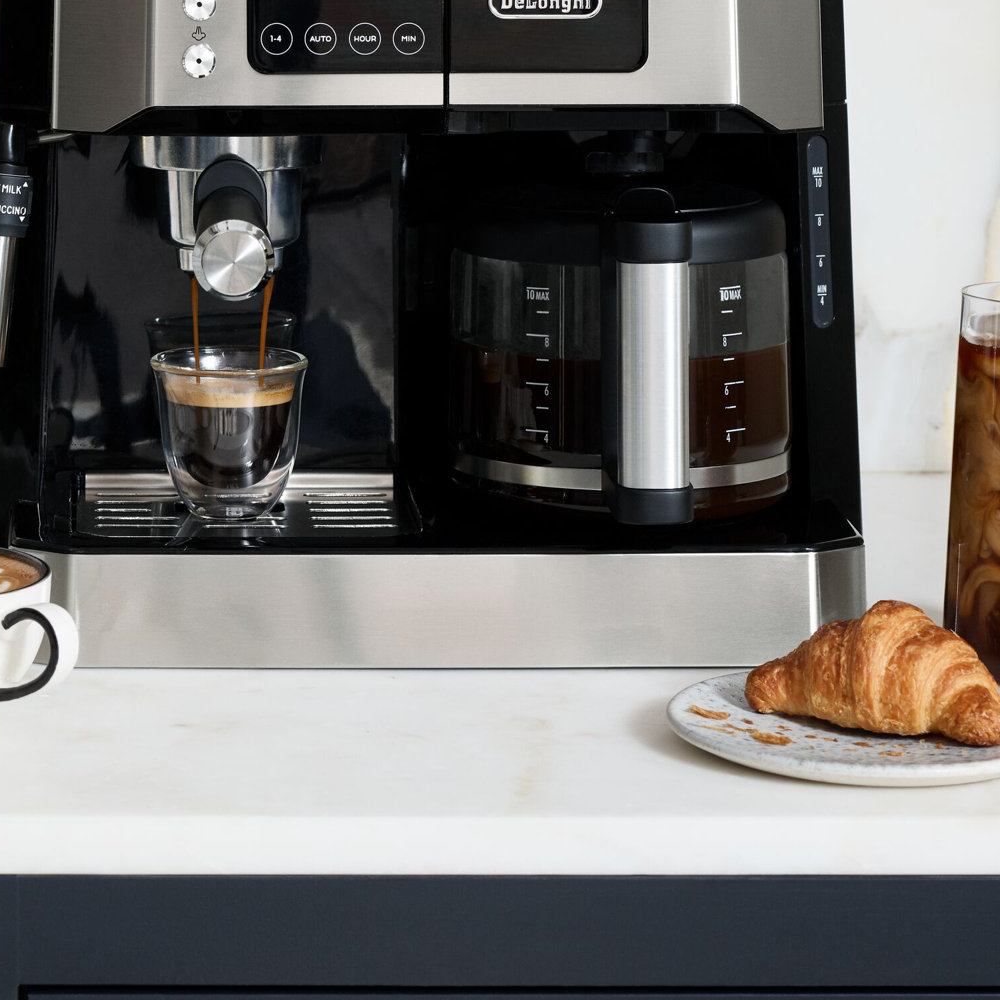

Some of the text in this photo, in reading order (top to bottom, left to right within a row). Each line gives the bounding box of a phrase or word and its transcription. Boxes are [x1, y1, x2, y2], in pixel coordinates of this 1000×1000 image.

[269, 34, 282, 43] 1-4
[309, 34, 332, 43] AUTO
[353, 34, 377, 43] HOUR
[401, 34, 417, 43] MIN
[812, 166, 823, 175] MAX
[815, 177, 823, 188] 10
[1, 184, 22, 195] MILK
[817, 216, 822, 227] 8
[818, 257, 824, 268] 6
[817, 284, 827, 293] MIN
[526, 289, 550, 301] 10 MAX
[720, 288, 742, 302] 10 MAX
[819, 295, 825, 306] 4
[544, 337, 550, 348] 8
[722, 336, 728, 347] 8
[544, 385, 549, 397] 6
[724, 385, 729, 396] 6
[543, 433, 549, 444] 4
[725, 432, 731, 443] 4
